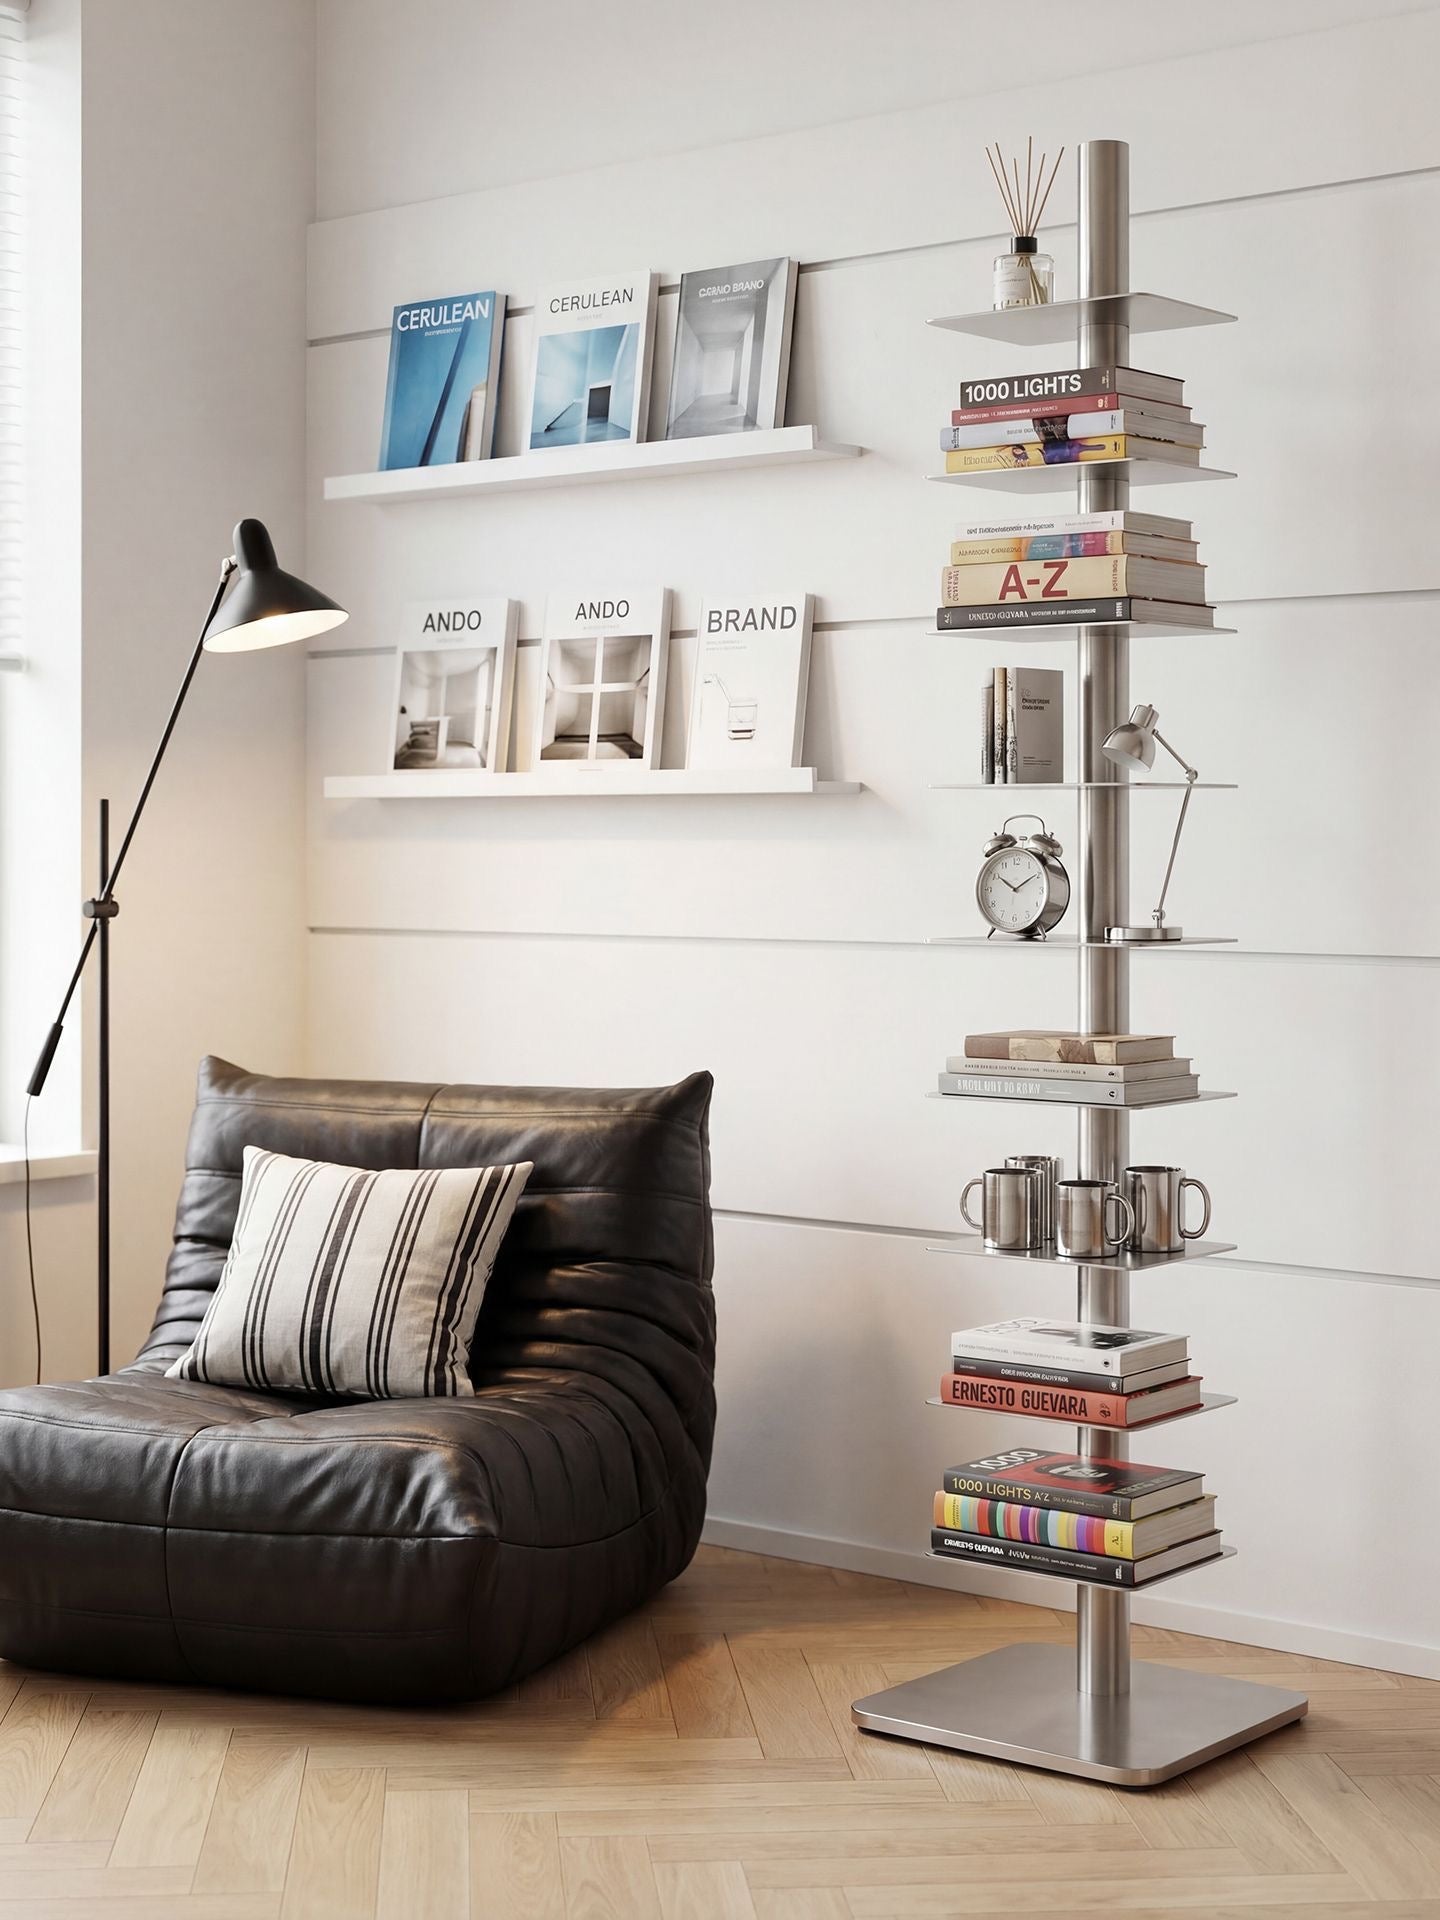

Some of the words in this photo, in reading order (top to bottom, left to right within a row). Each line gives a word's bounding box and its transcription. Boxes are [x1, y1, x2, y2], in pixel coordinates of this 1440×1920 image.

[550, 287, 634, 314] CERULEAN
[396, 299, 490, 332] CERULEAN
[965, 382, 1010, 403] 1000
[1013, 373, 1082, 398] LIGHTS
[998, 560, 1069, 600] A-Z
[422, 610, 482, 633] ANDO
[574, 599, 631, 620] ANDO
[707, 605, 797, 634] BRAND
[952, 1380, 1016, 1407] ERNESTO
[1021, 1389, 1088, 1418] GUEVARA
[969, 1450, 1039, 1470] 1000
[952, 1477, 983, 1493] 1000
[986, 1482, 1031, 1501] LIGHTS
